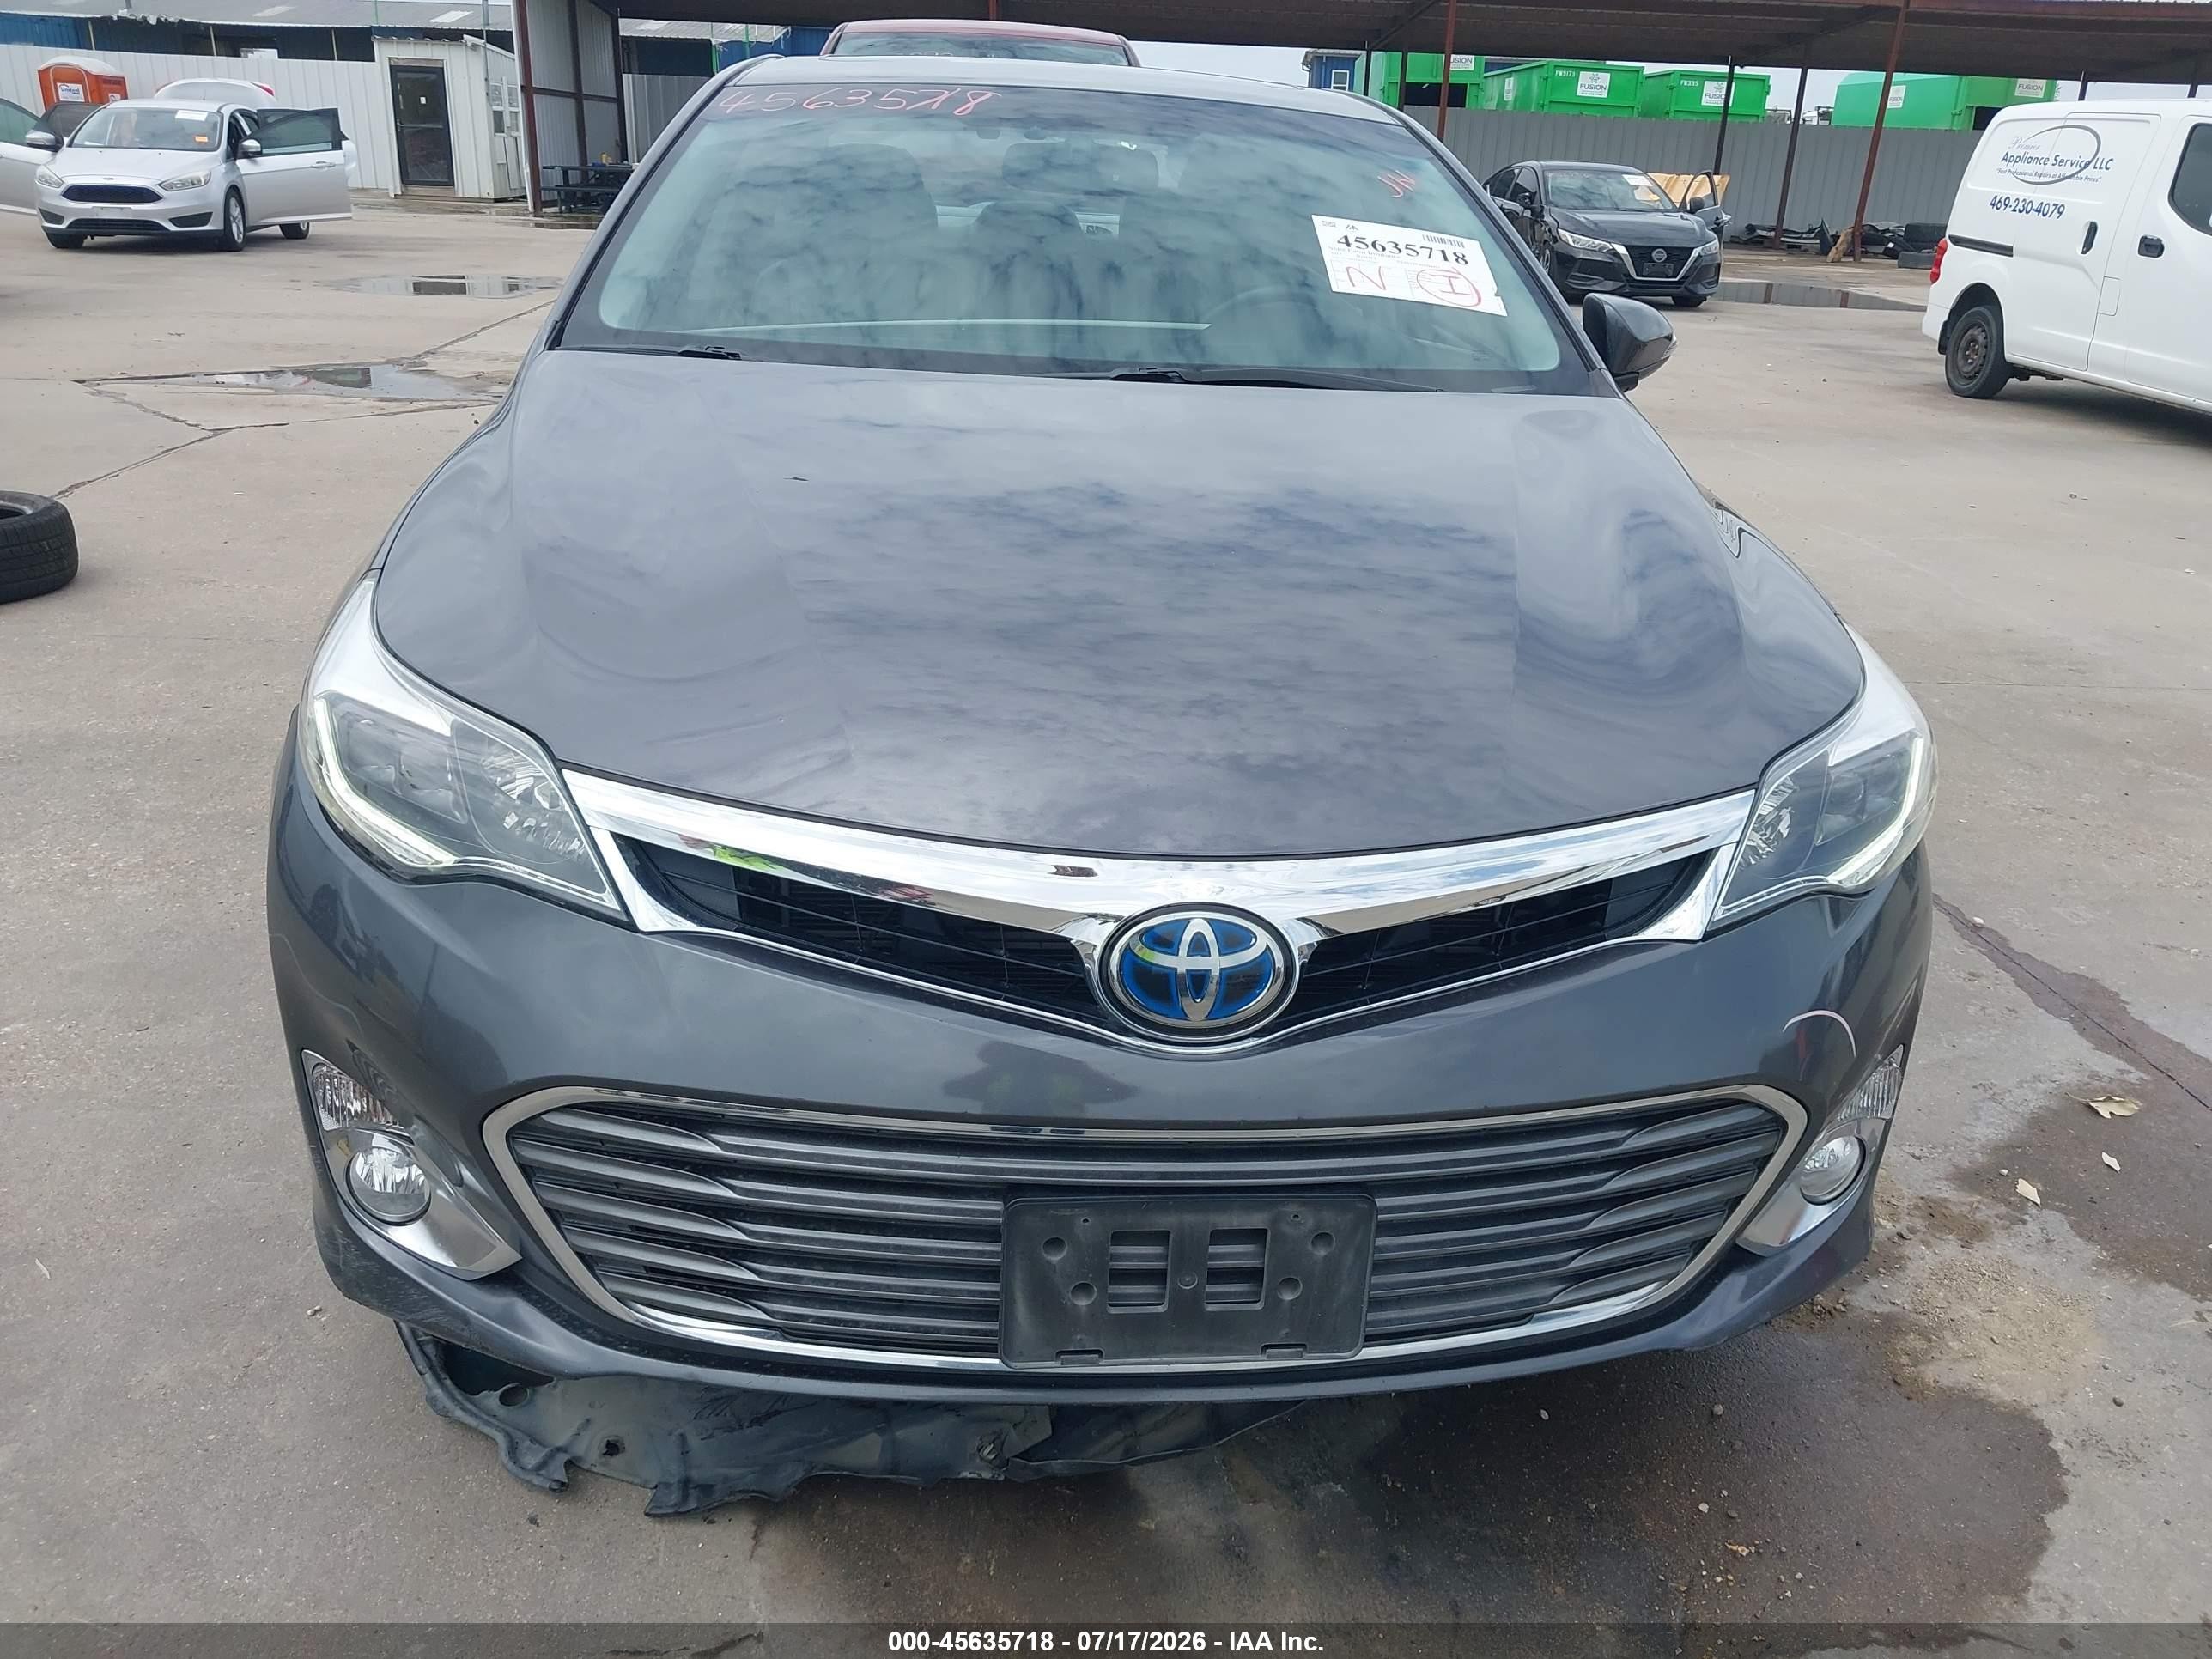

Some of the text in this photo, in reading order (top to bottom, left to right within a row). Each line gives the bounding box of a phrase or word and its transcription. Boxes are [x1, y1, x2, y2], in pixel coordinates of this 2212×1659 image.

[2001, 151, 2114, 171] Appliance Service LLC
[1990, 194, 2065, 219] 469-230-4079
[1337, 234, 1469, 265] 45635718
